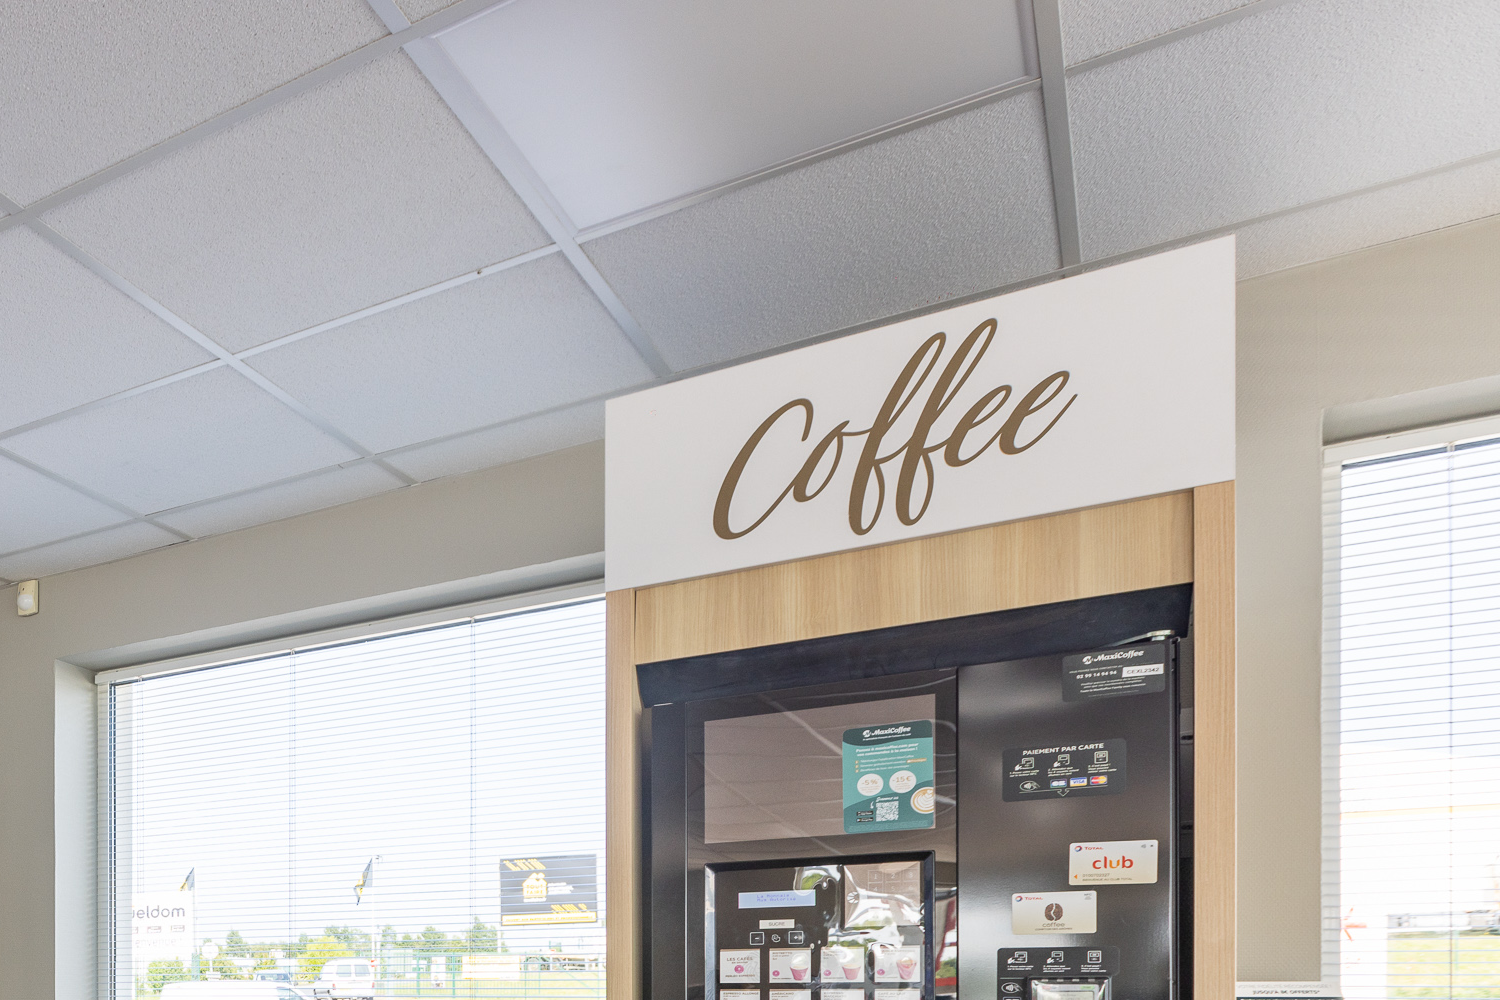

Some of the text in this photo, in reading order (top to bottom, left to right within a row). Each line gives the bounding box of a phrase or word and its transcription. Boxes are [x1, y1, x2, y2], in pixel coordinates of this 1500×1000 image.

[713, 318, 1078, 540] Coffee
[1094, 650, 1144, 662] MaxiCoffee
[871, 726, 911, 736] MaxiCoffee
[1022, 747, 1060, 756] PAIEMENT
[1078, 743, 1104, 751] CARTE
[1092, 855, 1134, 870] club
